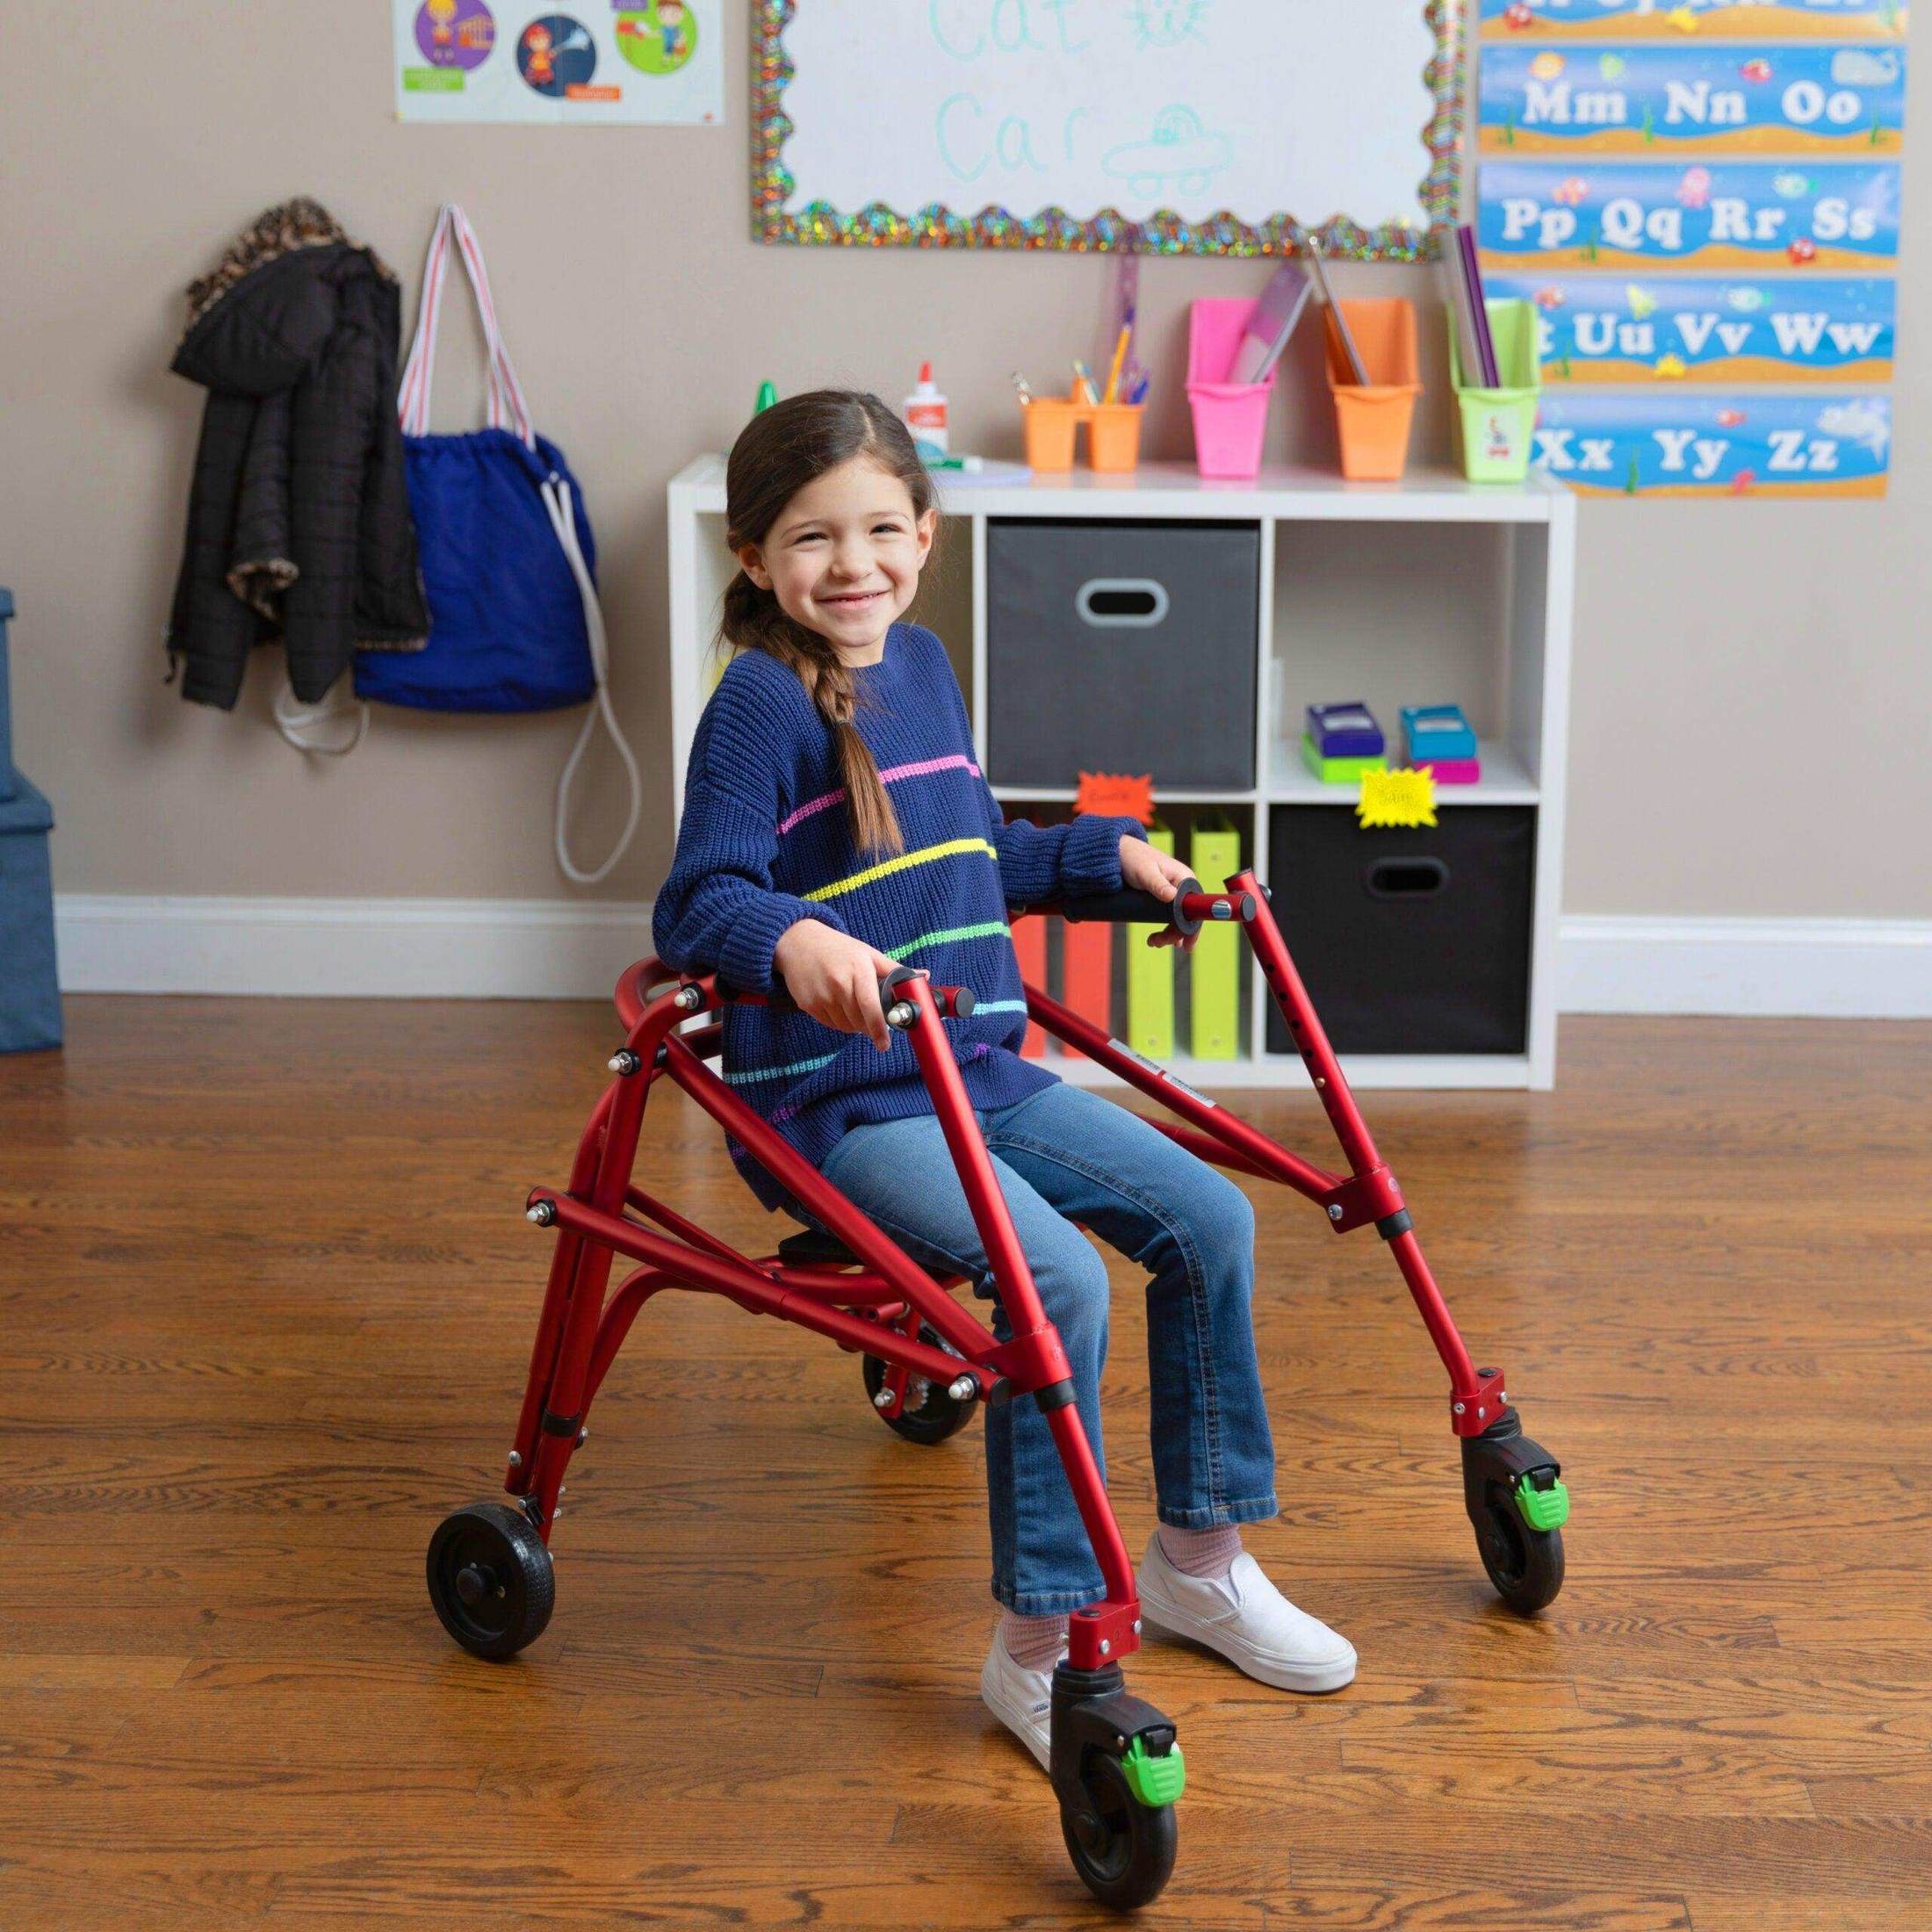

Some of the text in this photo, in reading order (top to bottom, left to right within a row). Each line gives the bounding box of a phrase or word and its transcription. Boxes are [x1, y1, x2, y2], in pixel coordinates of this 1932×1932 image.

[927, 0, 1094, 61] Cat
[1524, 79, 1862, 125] Mm Nn Oo
[935, 91, 1090, 182] Car
[1502, 197, 1877, 249] Pp Qq Rr Ss
[1573, 313, 1655, 355] Uu
[1674, 313, 1753, 355] Vv
[1770, 313, 1882, 356] Ww
[1533, 429, 1839, 479] Xx Yy Zz
